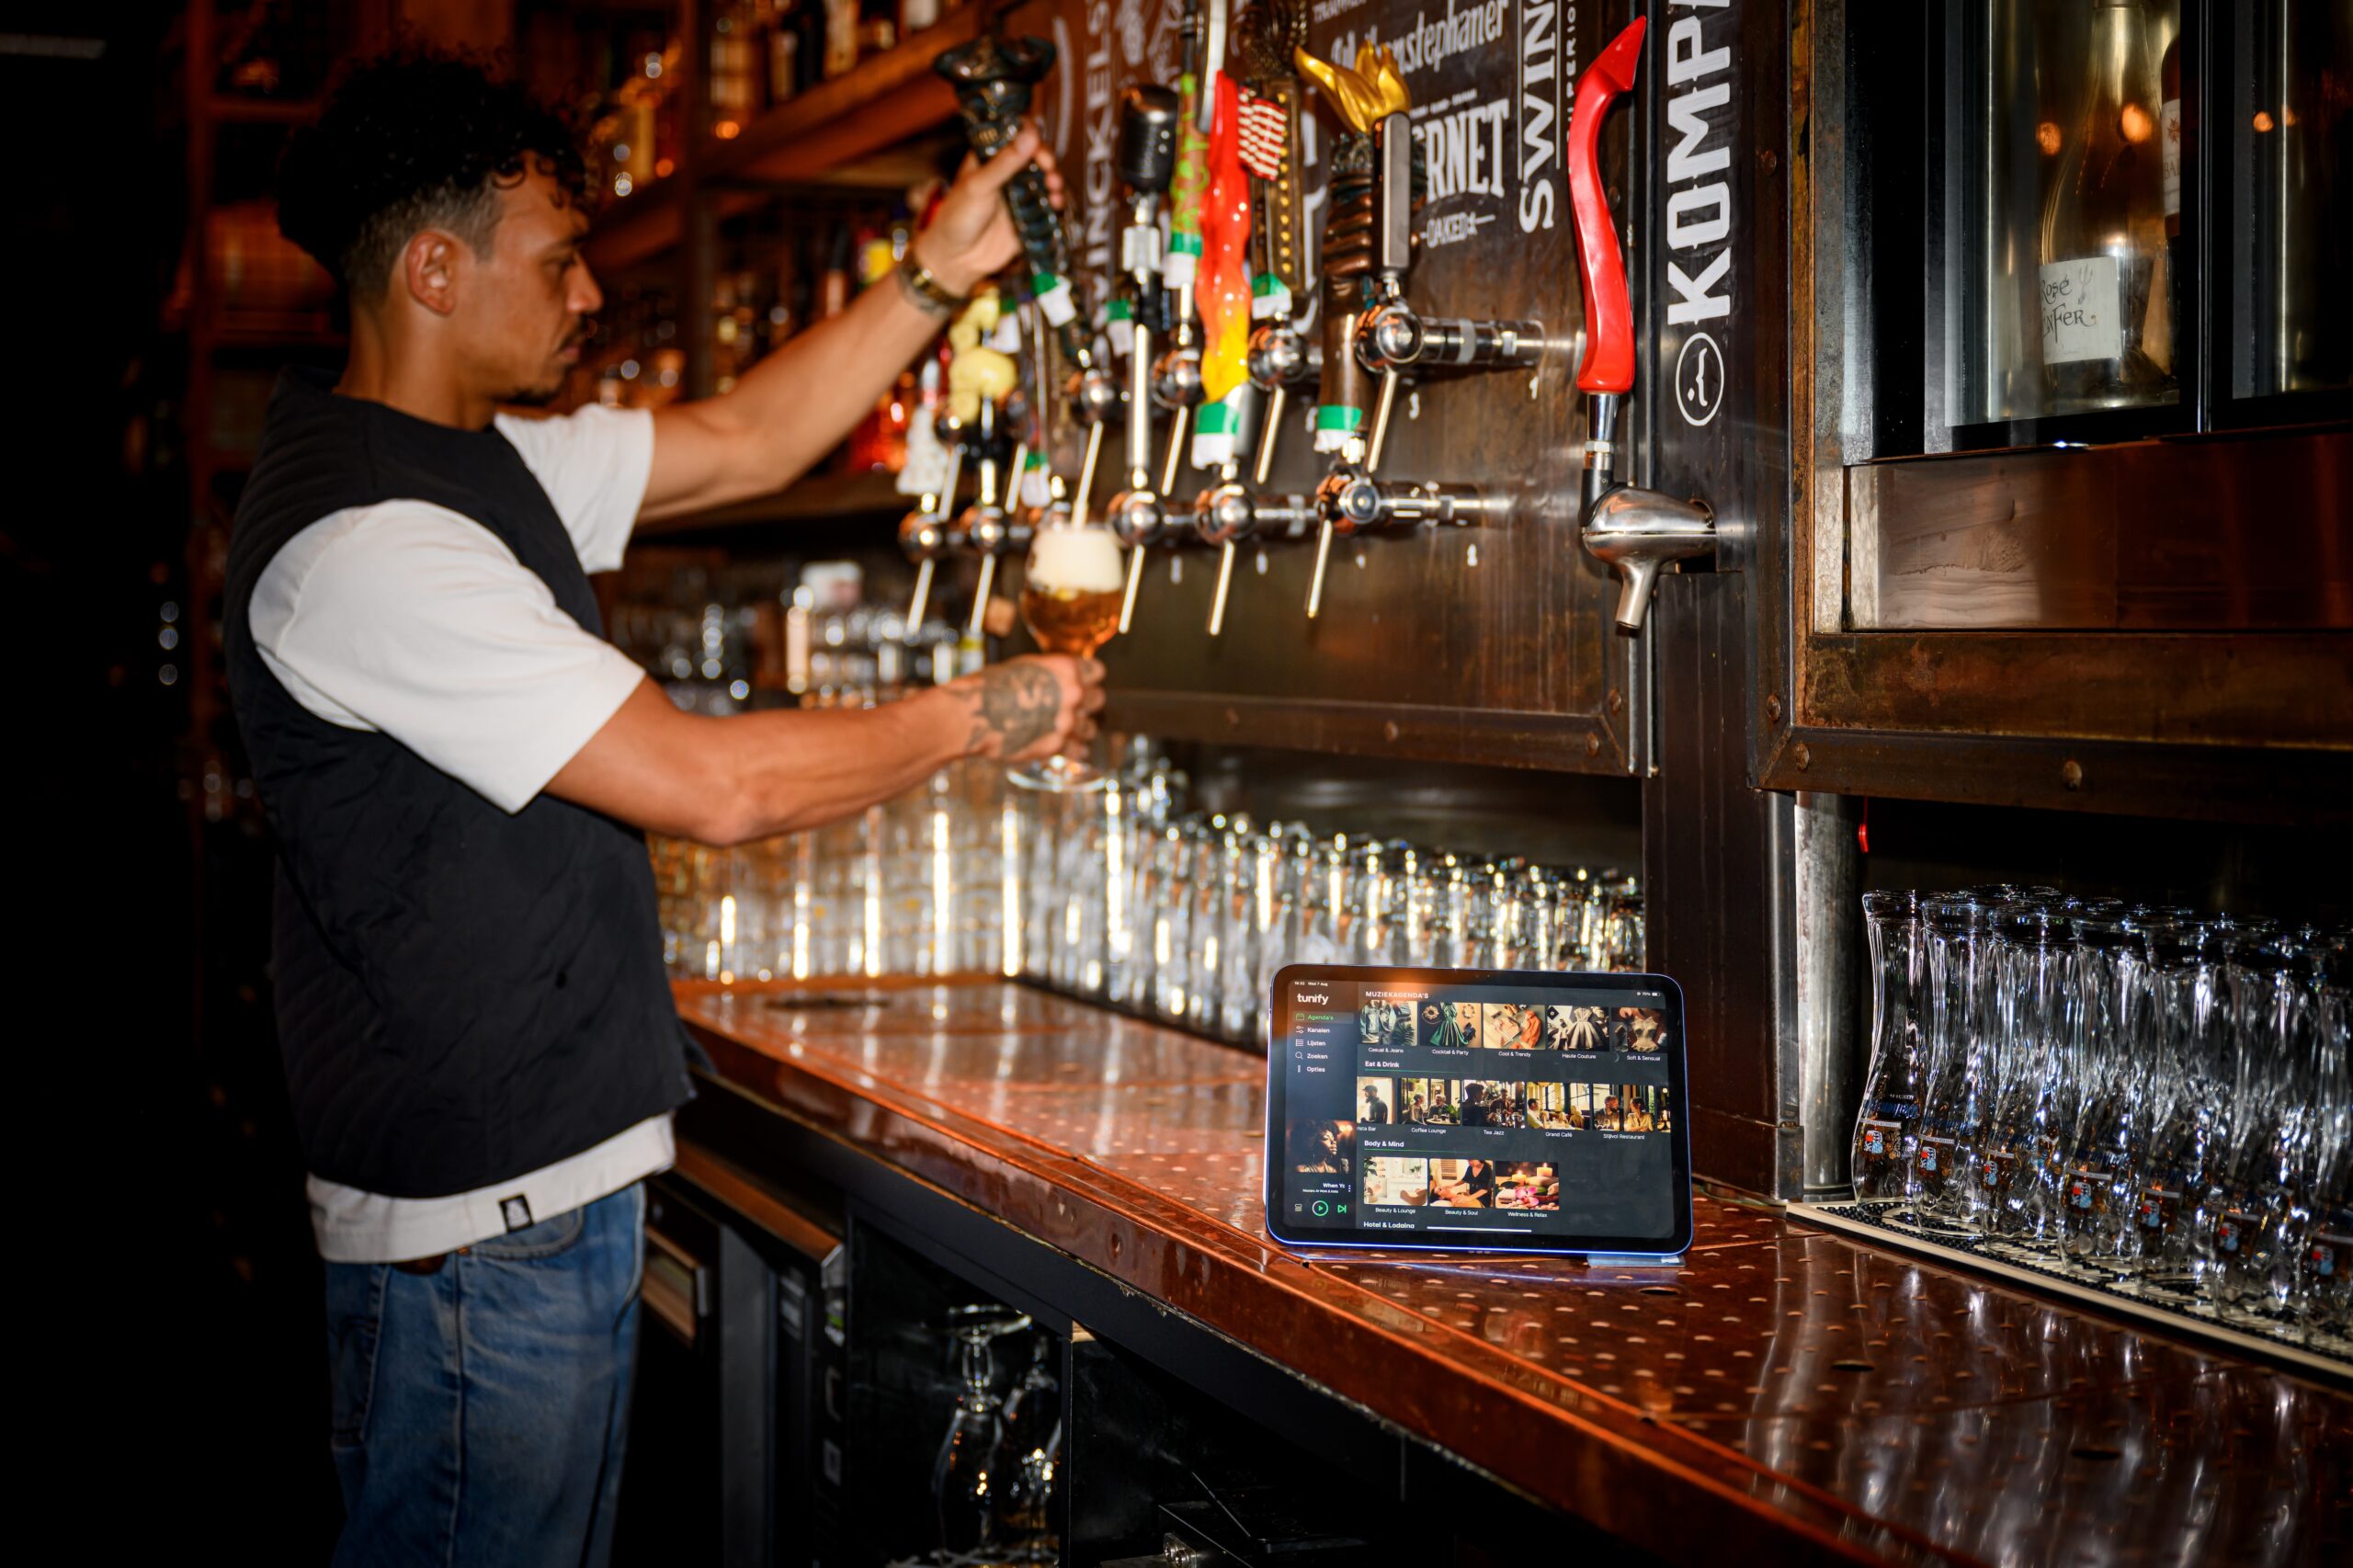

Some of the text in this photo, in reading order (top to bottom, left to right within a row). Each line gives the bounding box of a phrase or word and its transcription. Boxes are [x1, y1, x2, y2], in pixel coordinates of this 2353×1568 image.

[1518, 0, 1555, 233] SWIN
[1666, 0, 1731, 325] KOMP
[1297, 993, 1329, 1005] tunify
